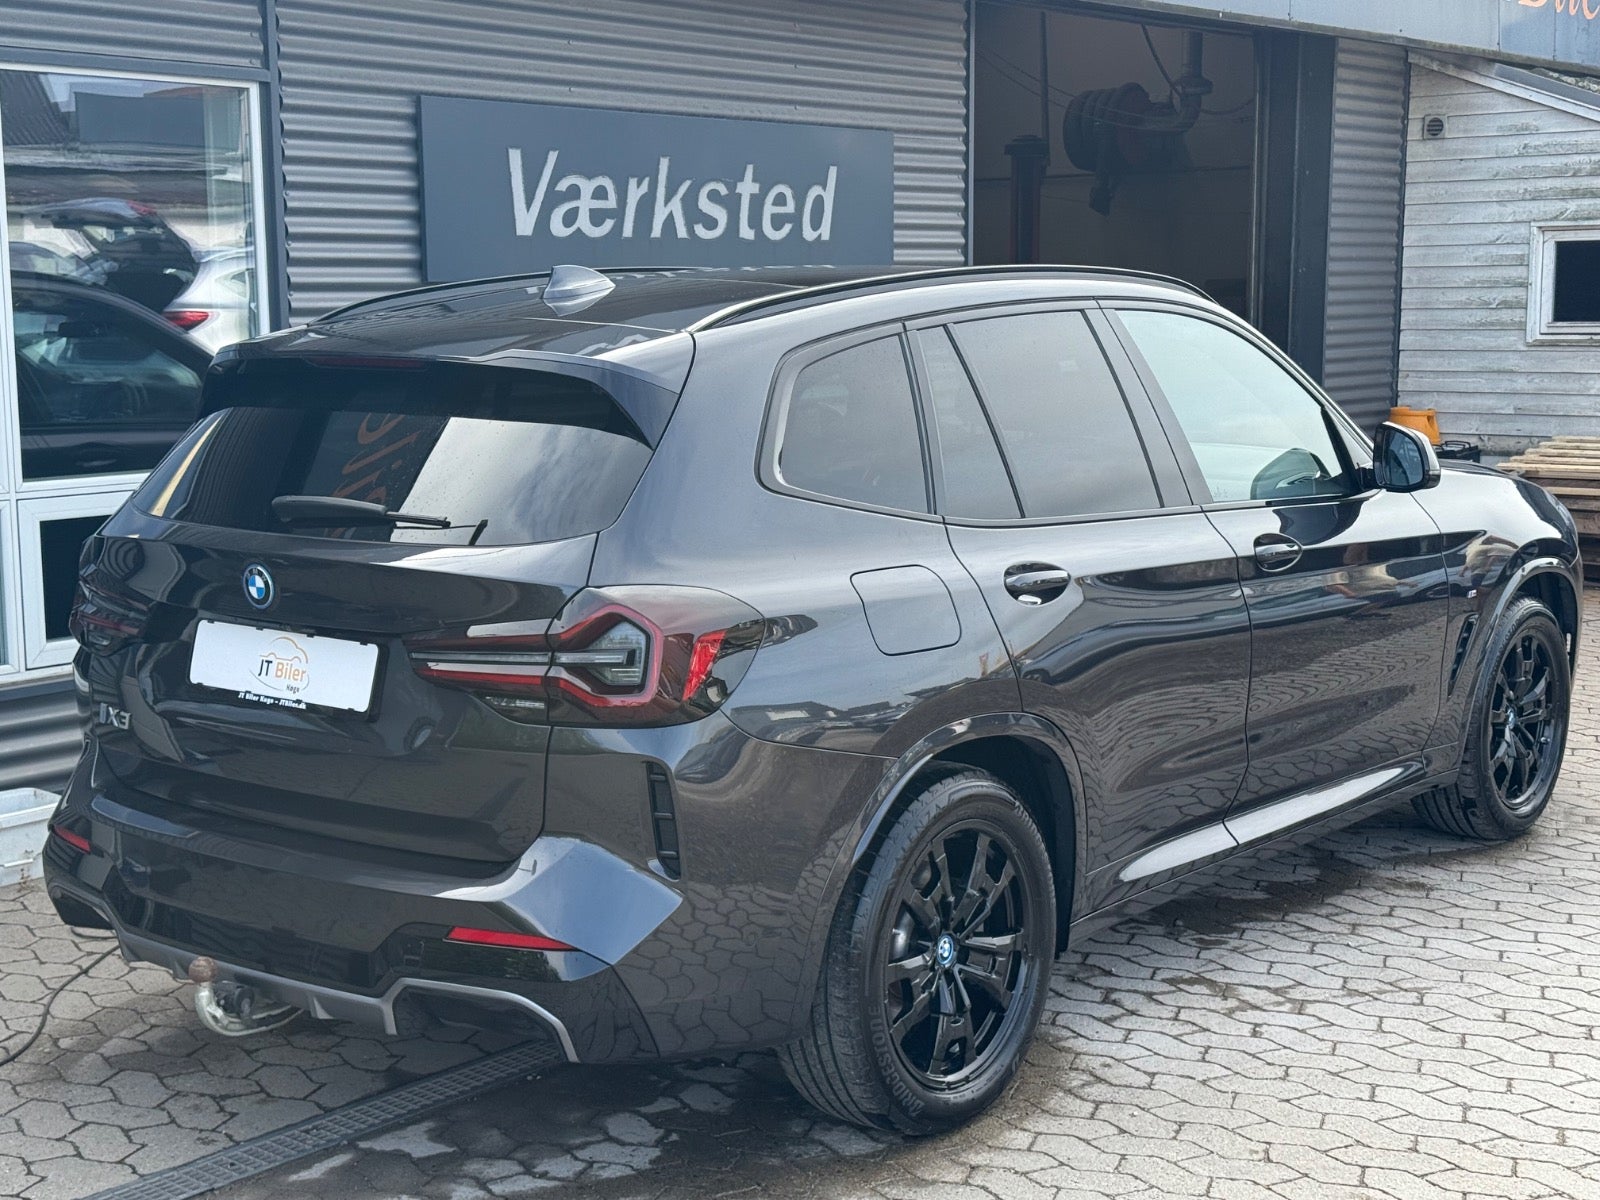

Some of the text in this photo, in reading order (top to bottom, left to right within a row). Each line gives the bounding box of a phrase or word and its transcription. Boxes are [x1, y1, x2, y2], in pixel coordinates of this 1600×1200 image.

[508, 147, 837, 241] Værksted
[258, 659, 307, 682] JT Biler
[245, 693, 259, 702] Biler
